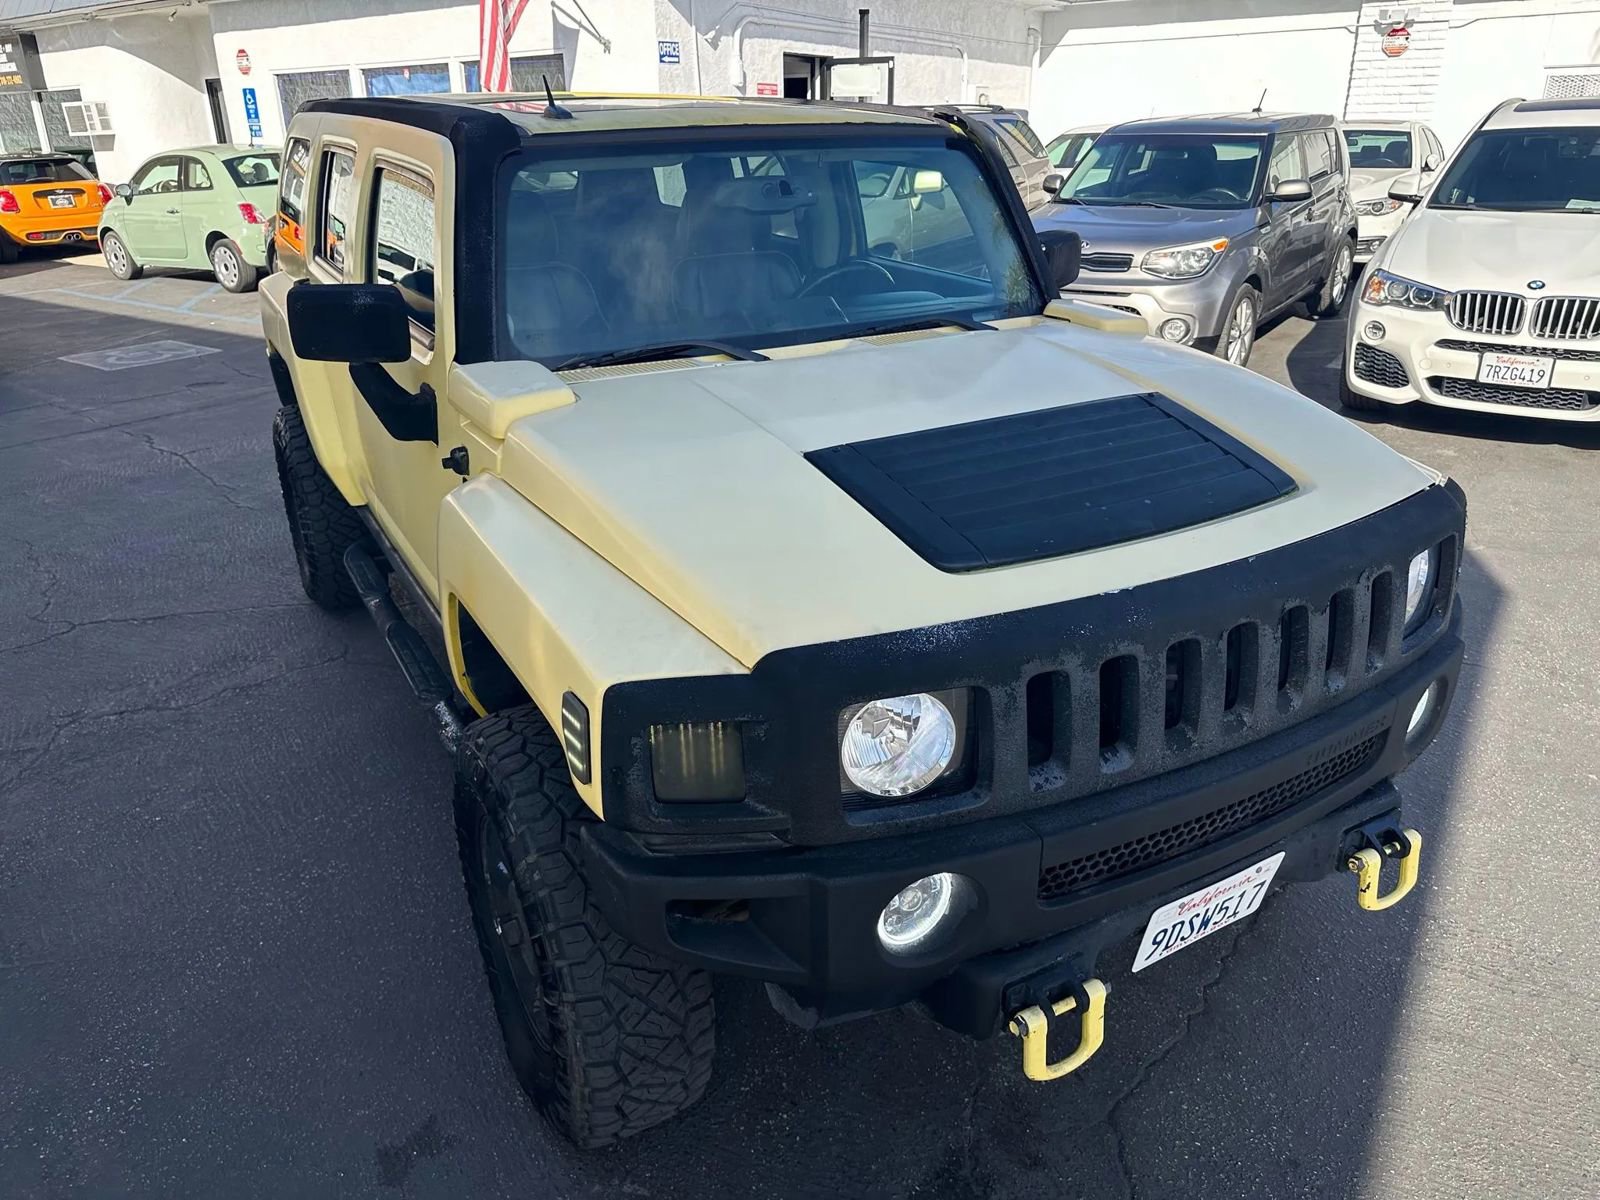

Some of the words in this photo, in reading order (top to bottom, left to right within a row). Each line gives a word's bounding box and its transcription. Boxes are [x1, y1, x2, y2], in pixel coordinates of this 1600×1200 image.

[659, 42, 679, 55] OFFICE
[1497, 356, 1537, 366] California
[1486, 364, 1546, 383] 7RZG419
[1178, 875, 1257, 916] California
[1144, 879, 1267, 961] 9DSW517
